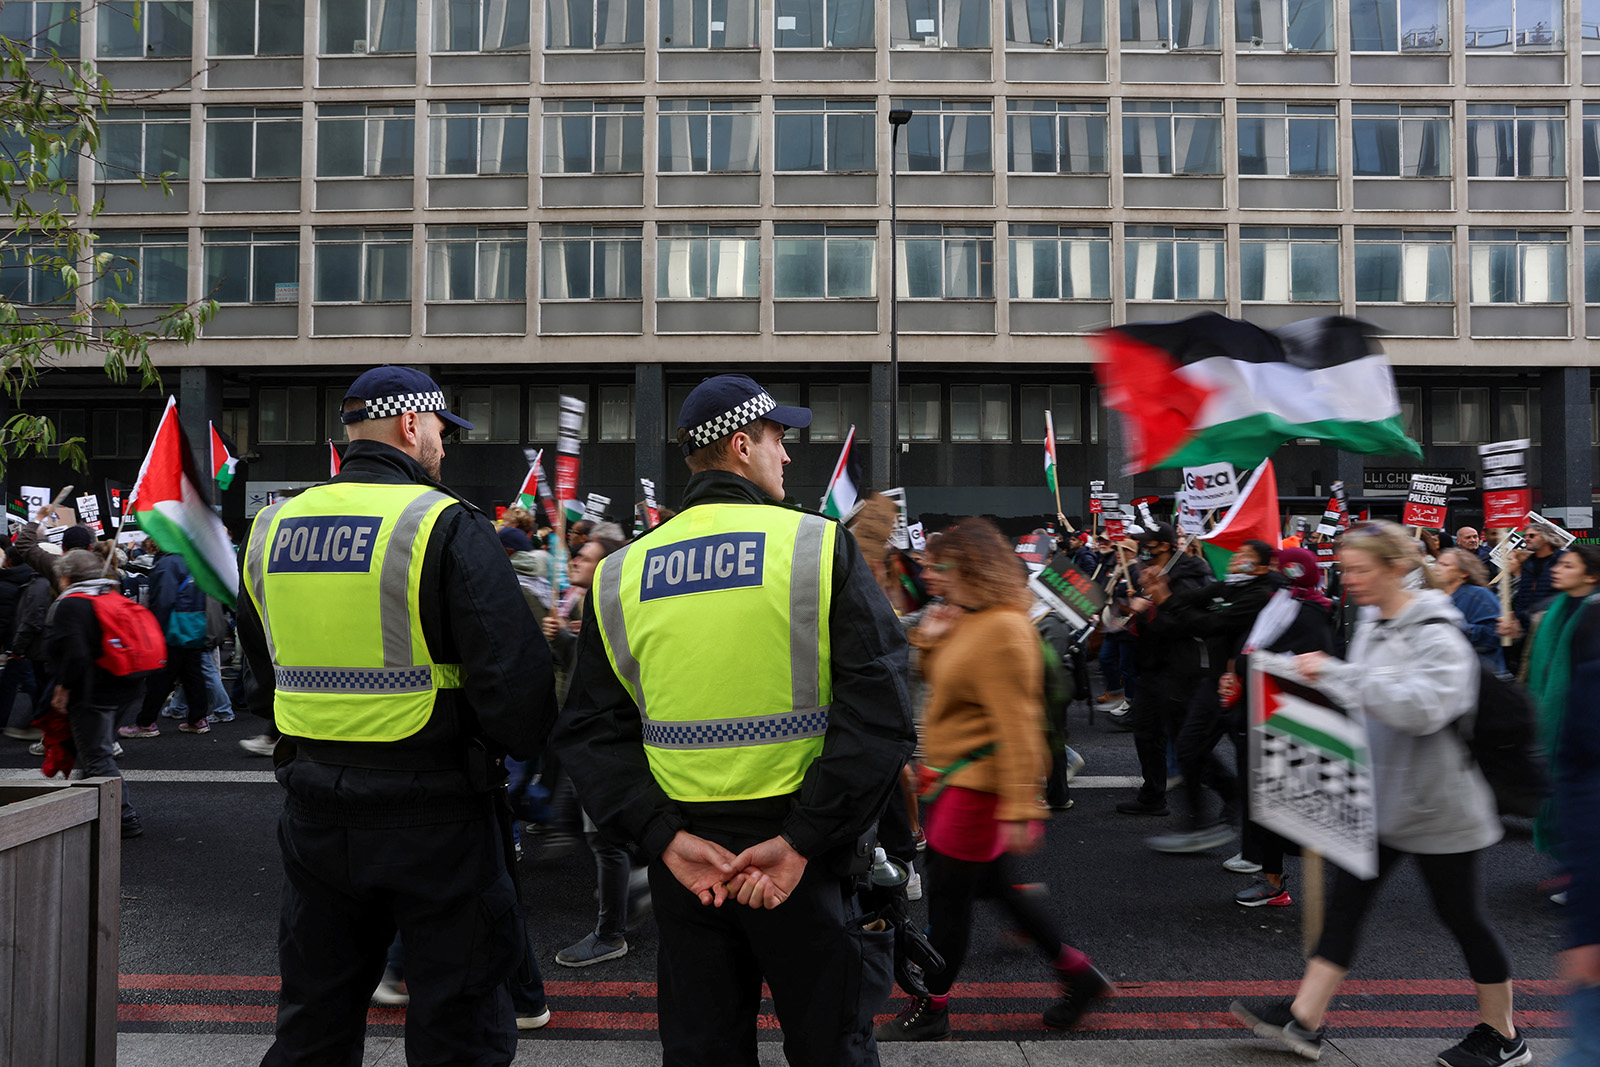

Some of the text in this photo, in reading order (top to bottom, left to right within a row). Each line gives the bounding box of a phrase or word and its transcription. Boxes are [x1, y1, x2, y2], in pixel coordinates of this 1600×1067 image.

[1186, 471, 1230, 490] Gza
[1412, 482, 1448, 494] FREEDOM
[1408, 493, 1447, 506] PALESTINE
[273, 526, 372, 562] POLICE
[646, 541, 757, 589] POLICE
[1040, 567, 1098, 616] PALESTINE
[1062, 568, 1093, 594] FREE
